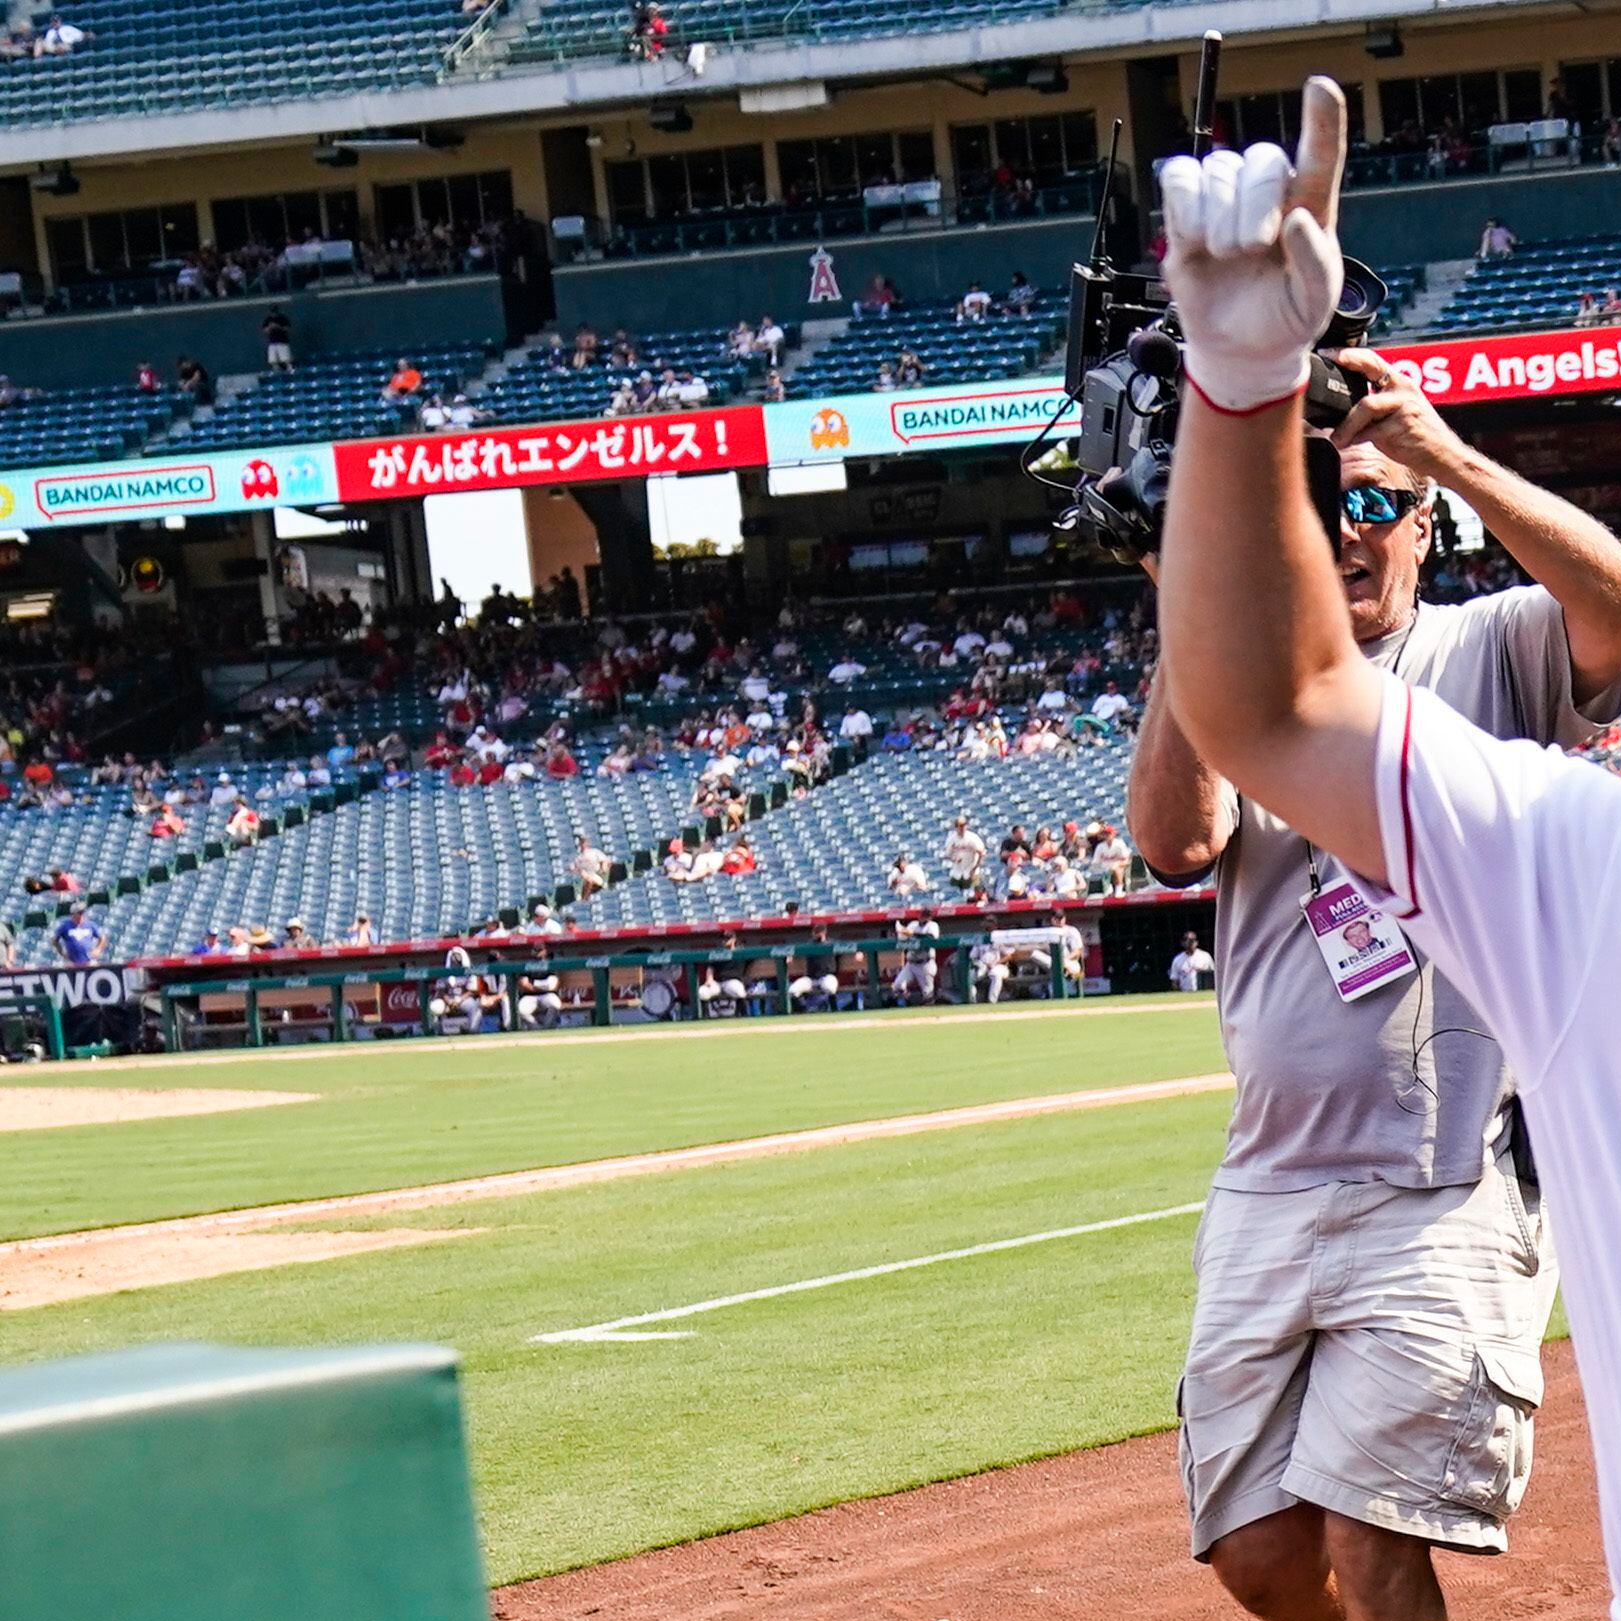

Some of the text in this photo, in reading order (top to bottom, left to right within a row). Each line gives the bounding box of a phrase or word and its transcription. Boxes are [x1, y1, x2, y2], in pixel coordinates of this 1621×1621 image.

[903, 396, 1076, 430] BANDAI NAMCO
[45, 475, 205, 507] BANDAI NAMCO
